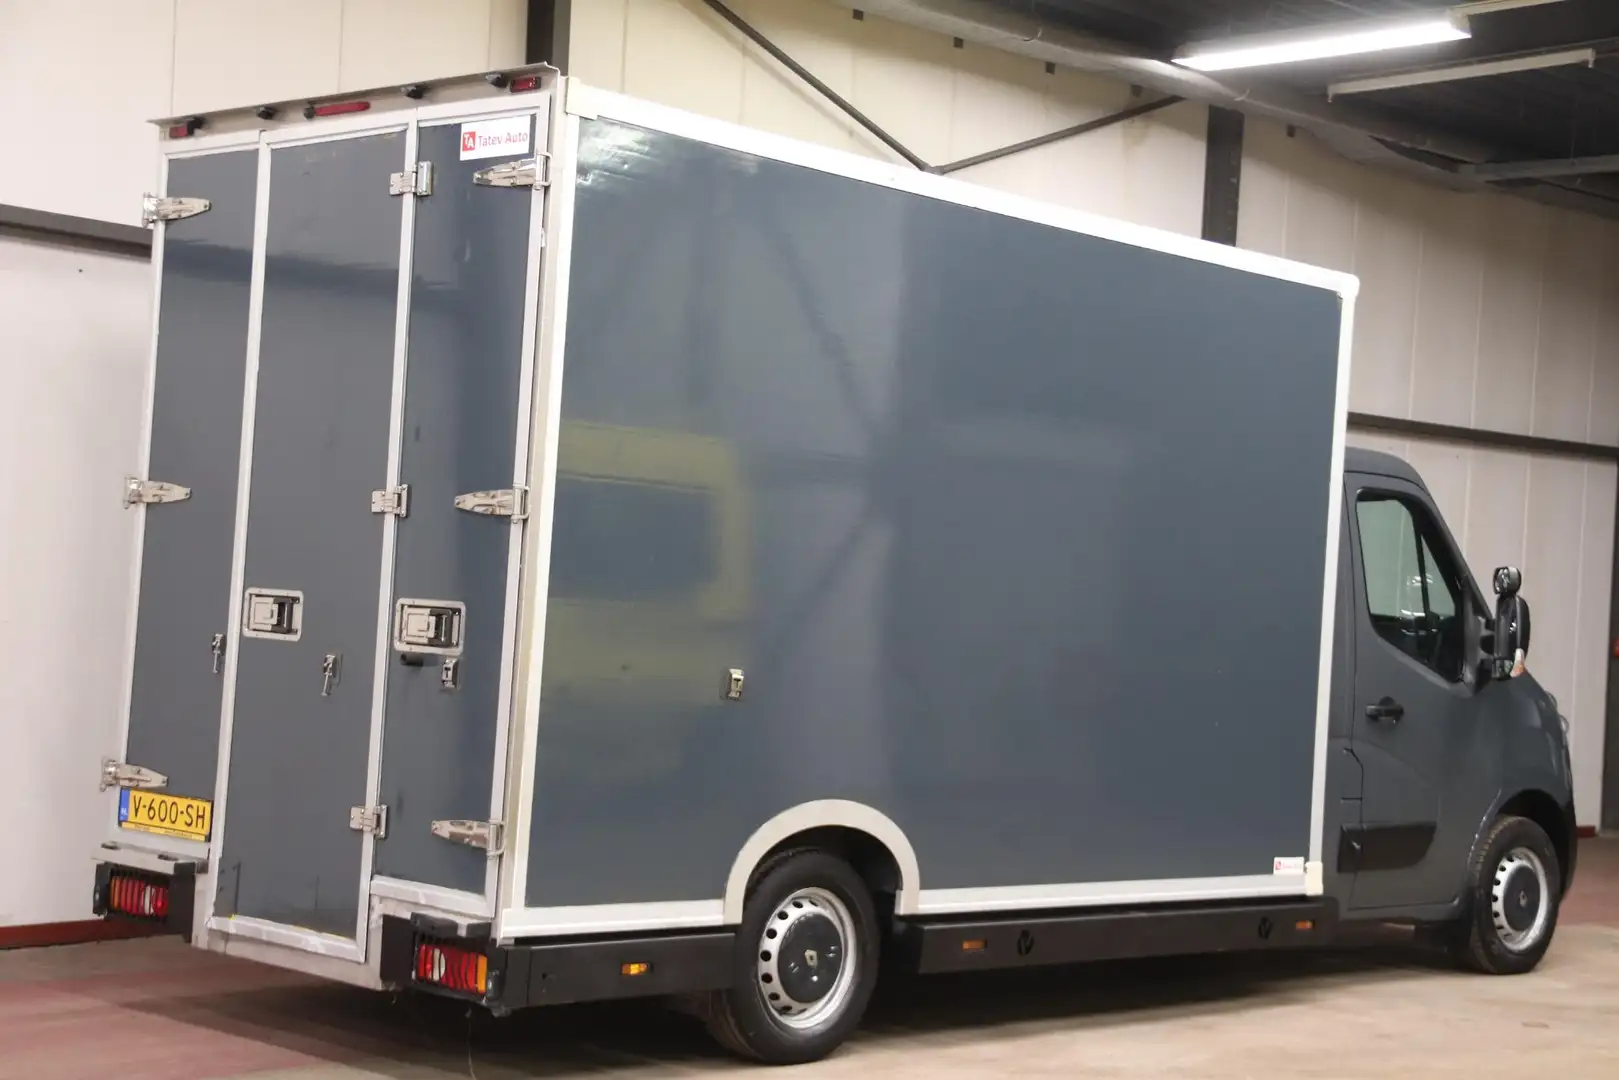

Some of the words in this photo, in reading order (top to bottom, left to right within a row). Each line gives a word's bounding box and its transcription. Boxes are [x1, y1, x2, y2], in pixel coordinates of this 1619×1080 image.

[478, 135, 502, 147] Tatev
[504, 132, 528, 144] Auto
[133, 795, 206, 829] V-600-SH
